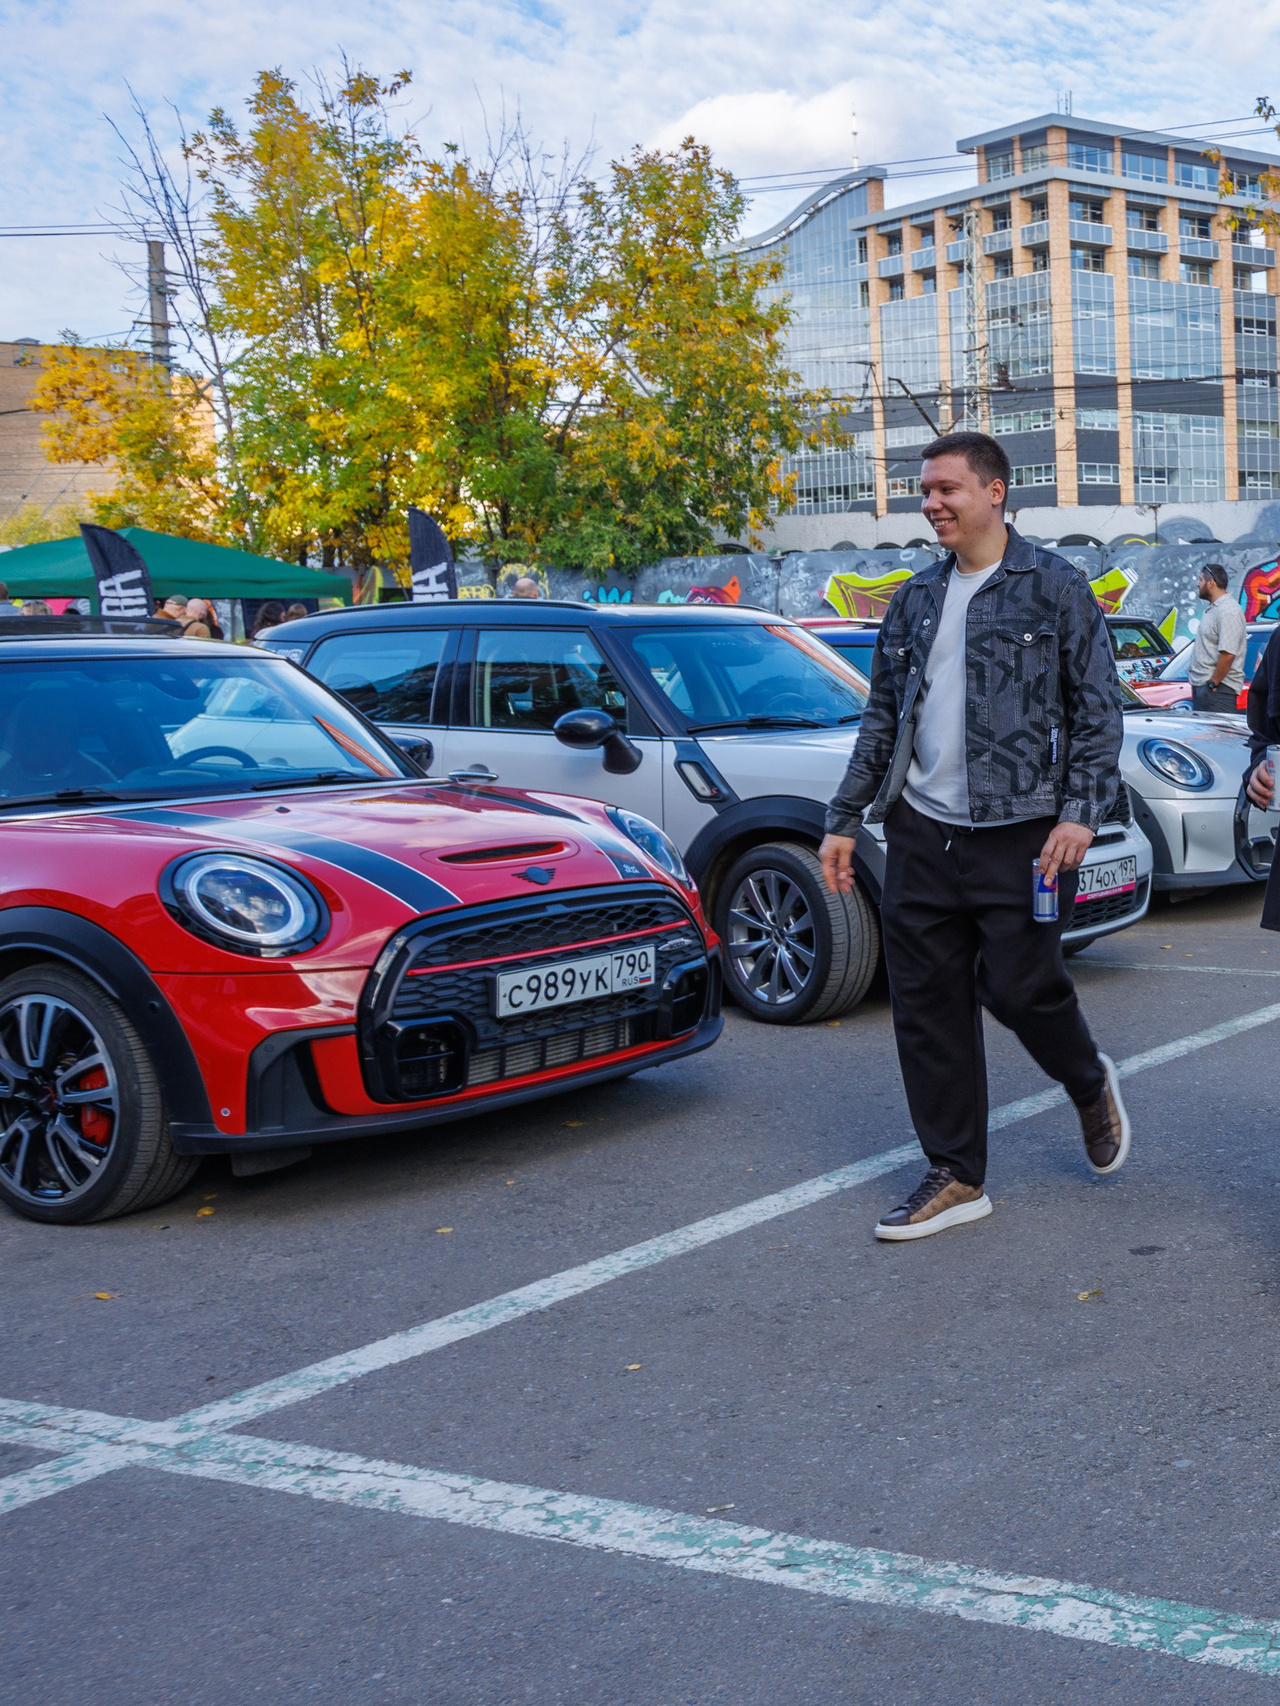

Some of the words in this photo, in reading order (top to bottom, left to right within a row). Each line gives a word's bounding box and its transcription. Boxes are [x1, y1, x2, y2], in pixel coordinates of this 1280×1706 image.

[1079, 867, 1117, 892] 374ОХ
[1119, 859, 1133, 877] 197
[613, 951, 649, 979] 790
[621, 976, 639, 987] RUS
